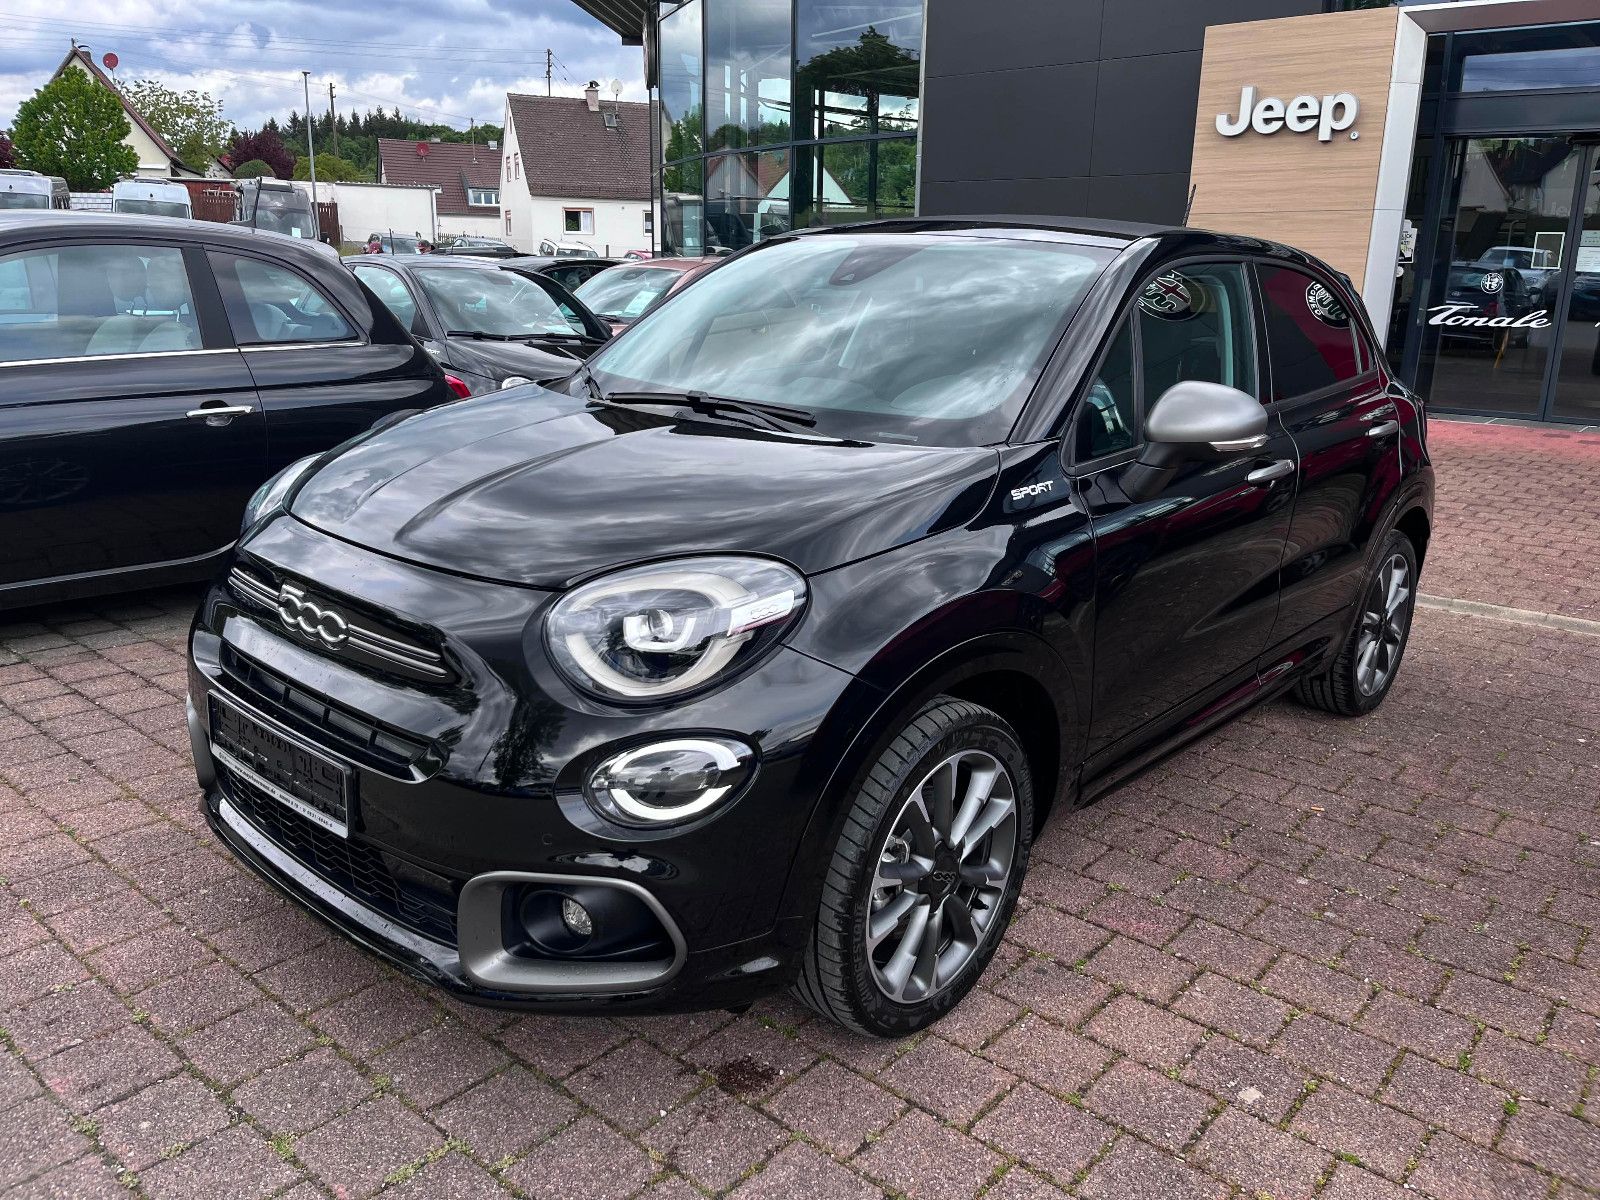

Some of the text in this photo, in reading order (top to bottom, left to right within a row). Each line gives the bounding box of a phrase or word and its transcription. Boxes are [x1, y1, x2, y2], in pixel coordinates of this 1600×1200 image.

[1215, 85, 1359, 142] Jeep
[1427, 300, 1552, 329] Tonale
[1010, 480, 1054, 501] SPORT
[279, 584, 347, 642] 500
